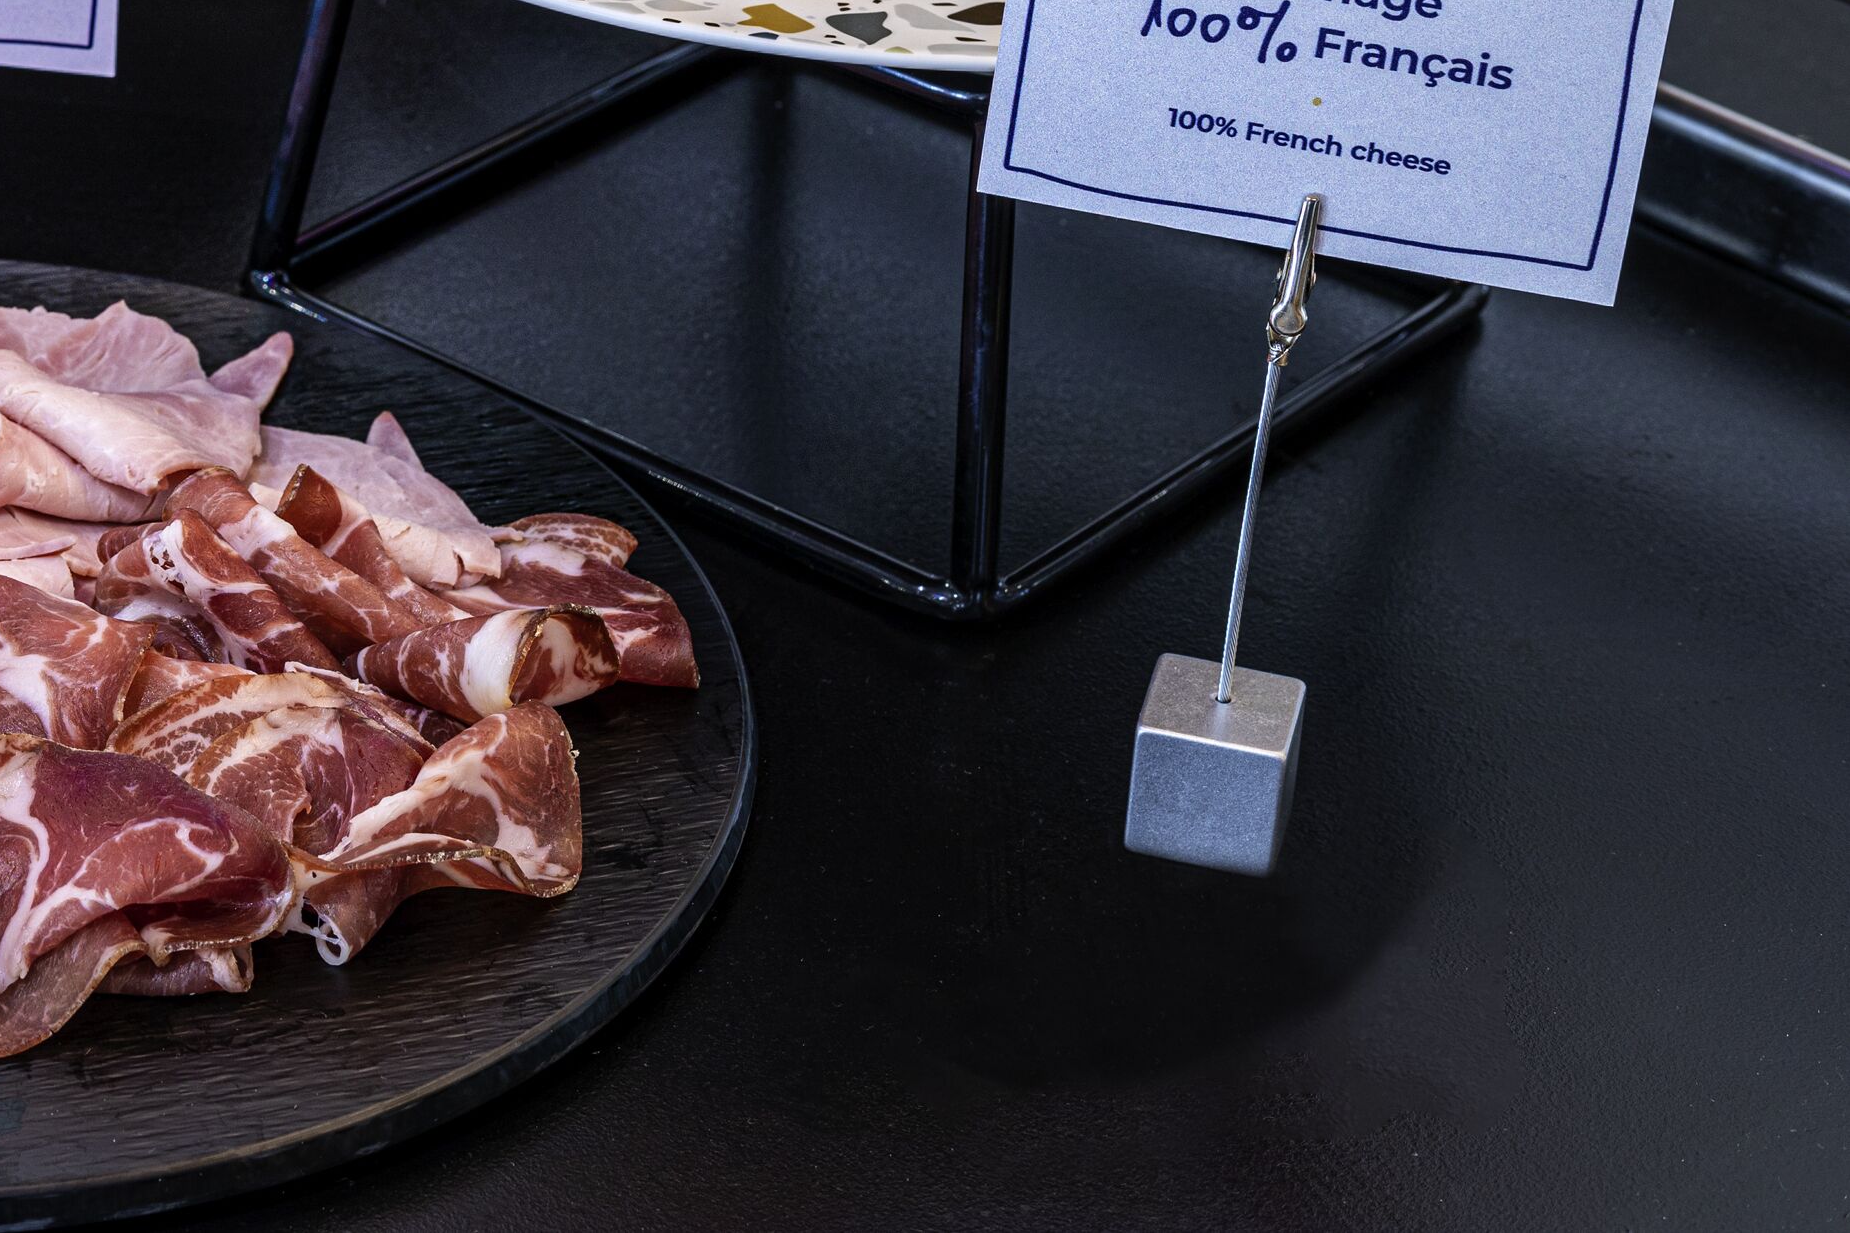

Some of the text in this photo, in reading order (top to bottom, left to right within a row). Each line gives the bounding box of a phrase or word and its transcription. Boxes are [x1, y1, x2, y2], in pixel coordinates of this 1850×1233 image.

[1314, 27, 1514, 91] Français
[1168, 107, 1452, 176] 100% French cheese
